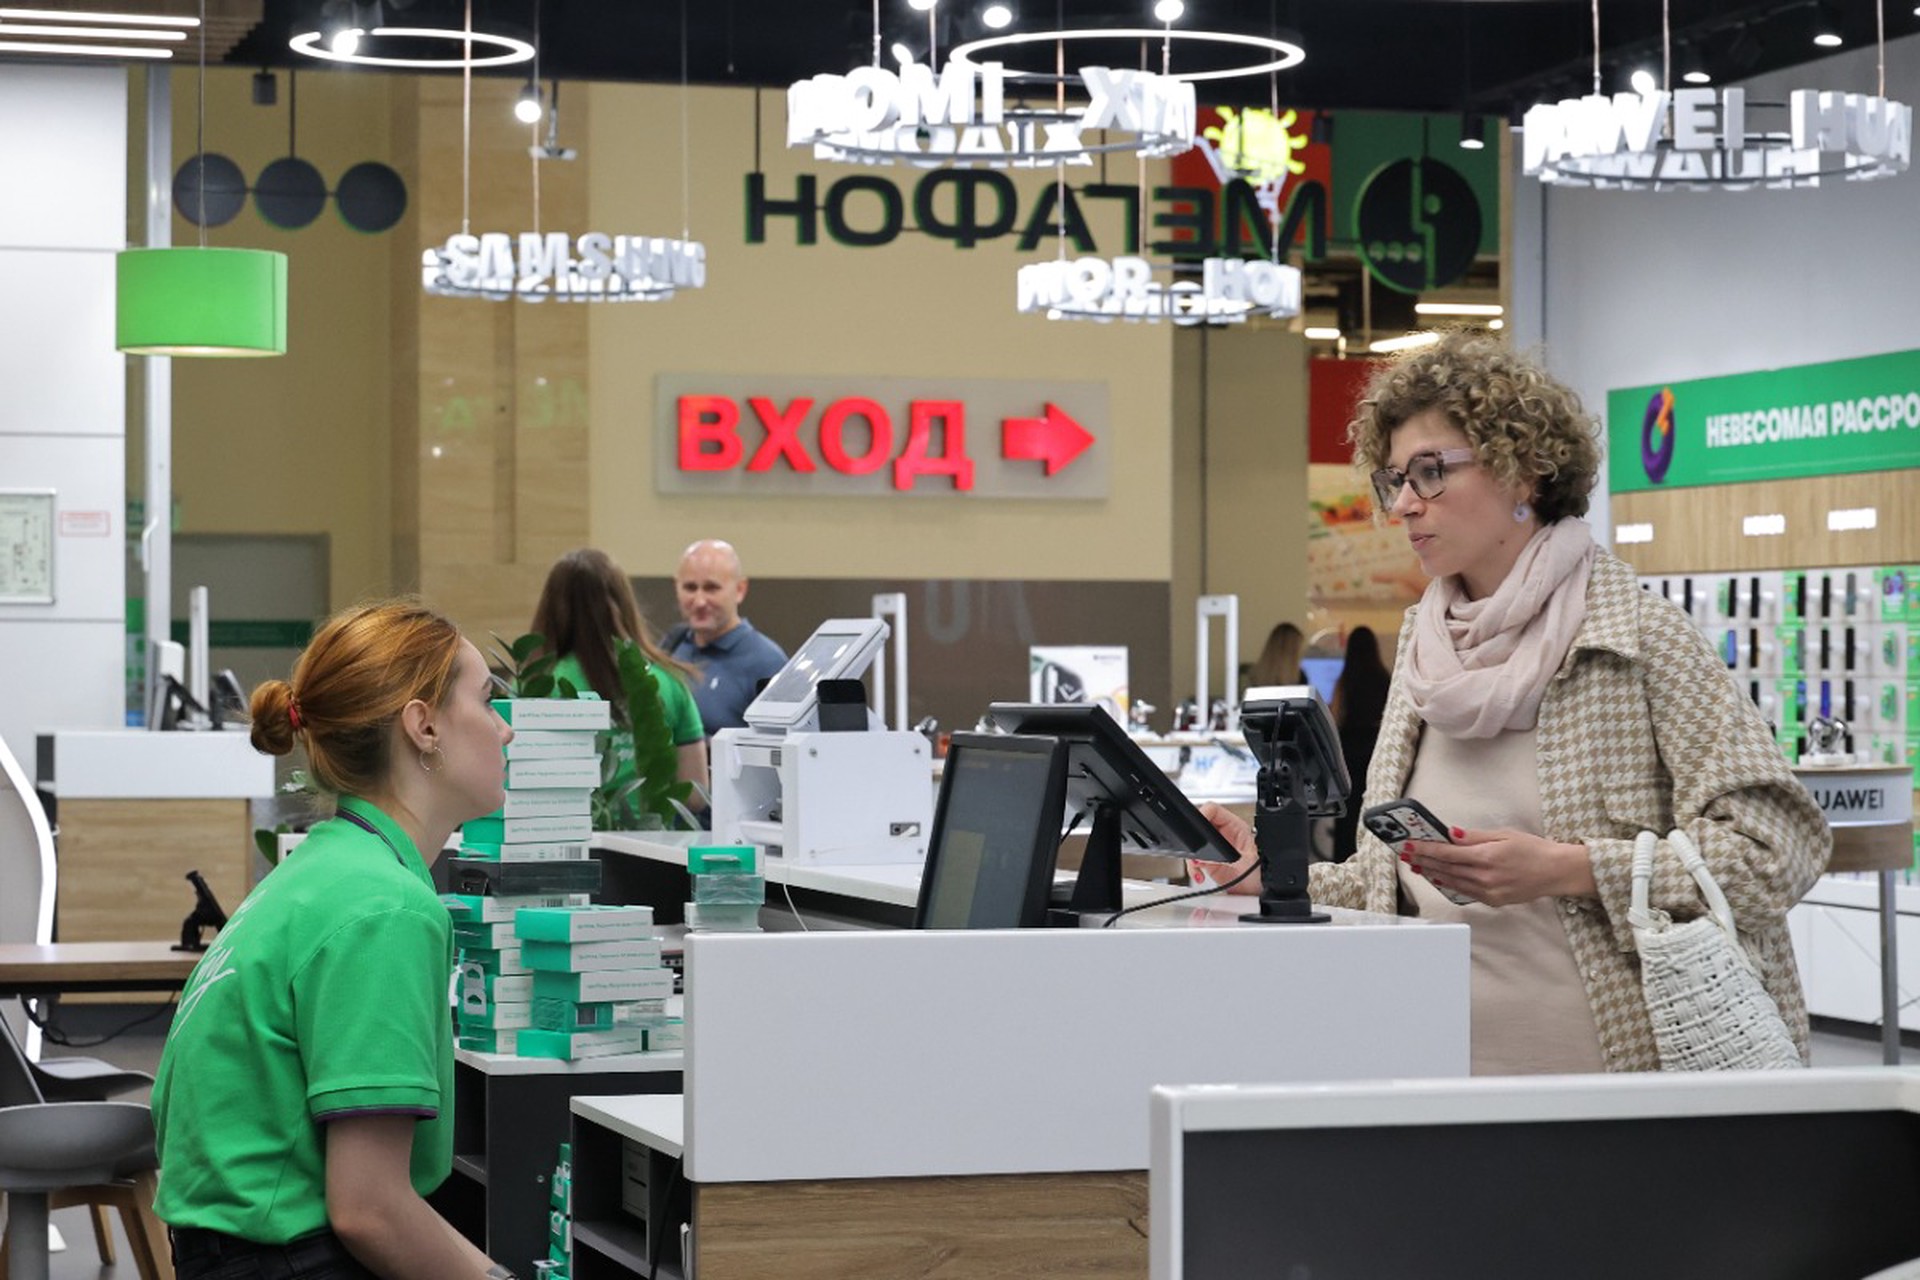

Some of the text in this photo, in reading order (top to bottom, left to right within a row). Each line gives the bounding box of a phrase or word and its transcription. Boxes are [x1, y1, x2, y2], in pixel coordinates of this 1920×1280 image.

[678, 395, 975, 492] ВХОД
[1705, 403, 1829, 448] НЕВЕСОМАЯ
[1815, 789, 1884, 811] UAWEI
